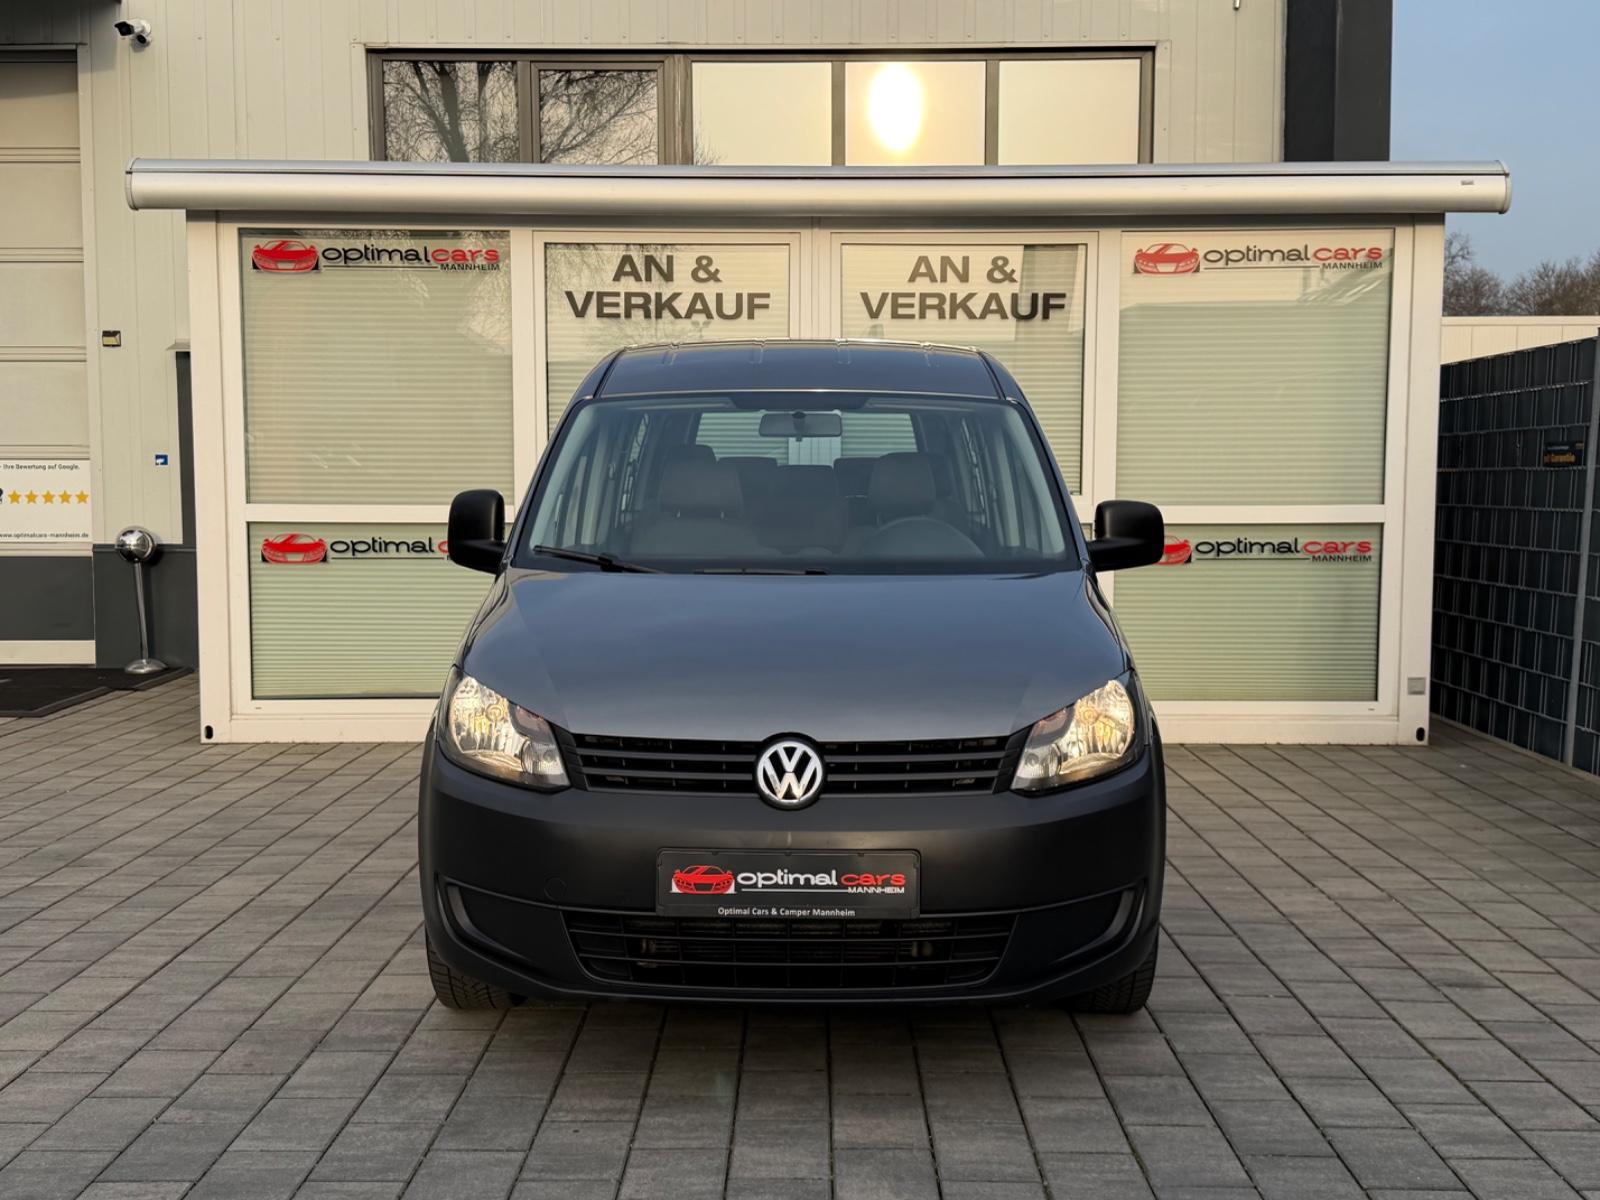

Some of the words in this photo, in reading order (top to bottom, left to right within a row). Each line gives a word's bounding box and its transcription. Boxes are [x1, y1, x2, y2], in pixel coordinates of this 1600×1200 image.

[440, 263, 501, 271] MANNHEIM
[612, 254, 675, 283] AN
[690, 255, 723, 283] &
[907, 255, 970, 284] AN
[986, 255, 1018, 284] &
[1321, 261, 1383, 270] MANNHEIM
[565, 290, 772, 321] VERKAUF
[860, 291, 1067, 321] VERKAUF
[16, 463, 47, 471] Bewertung
[1311, 554, 1373, 563] MANNHEIM
[847, 886, 905, 894] MANNHEIM
[717, 906, 750, 916] Optimal
[752, 907, 769, 915] Cars
[771, 907, 778, 915] &
[779, 907, 811, 917] Camper
[812, 908, 856, 917] Mannheim
